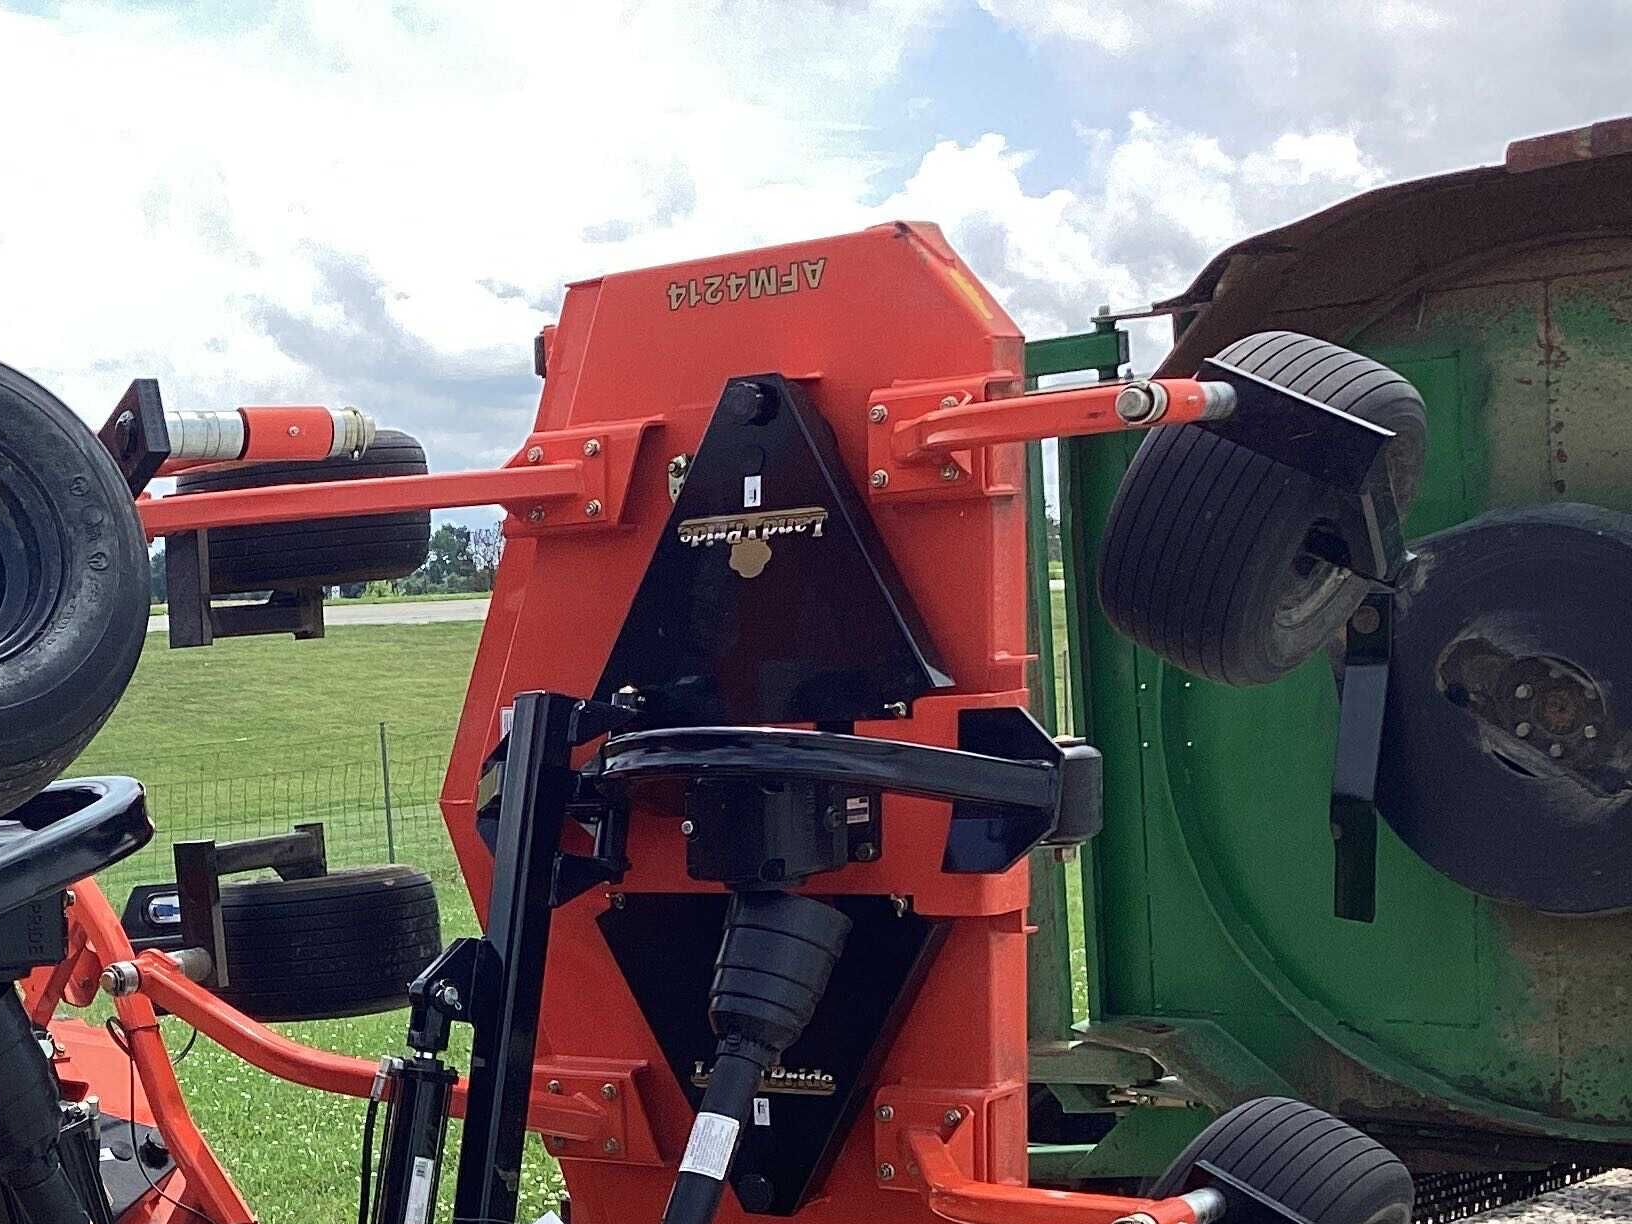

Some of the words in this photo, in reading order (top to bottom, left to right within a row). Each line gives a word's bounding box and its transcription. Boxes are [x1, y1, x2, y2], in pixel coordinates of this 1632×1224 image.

[667, 257, 827, 312] AFM4214
[678, 519, 745, 548] Pride
[761, 510, 828, 541] Land
